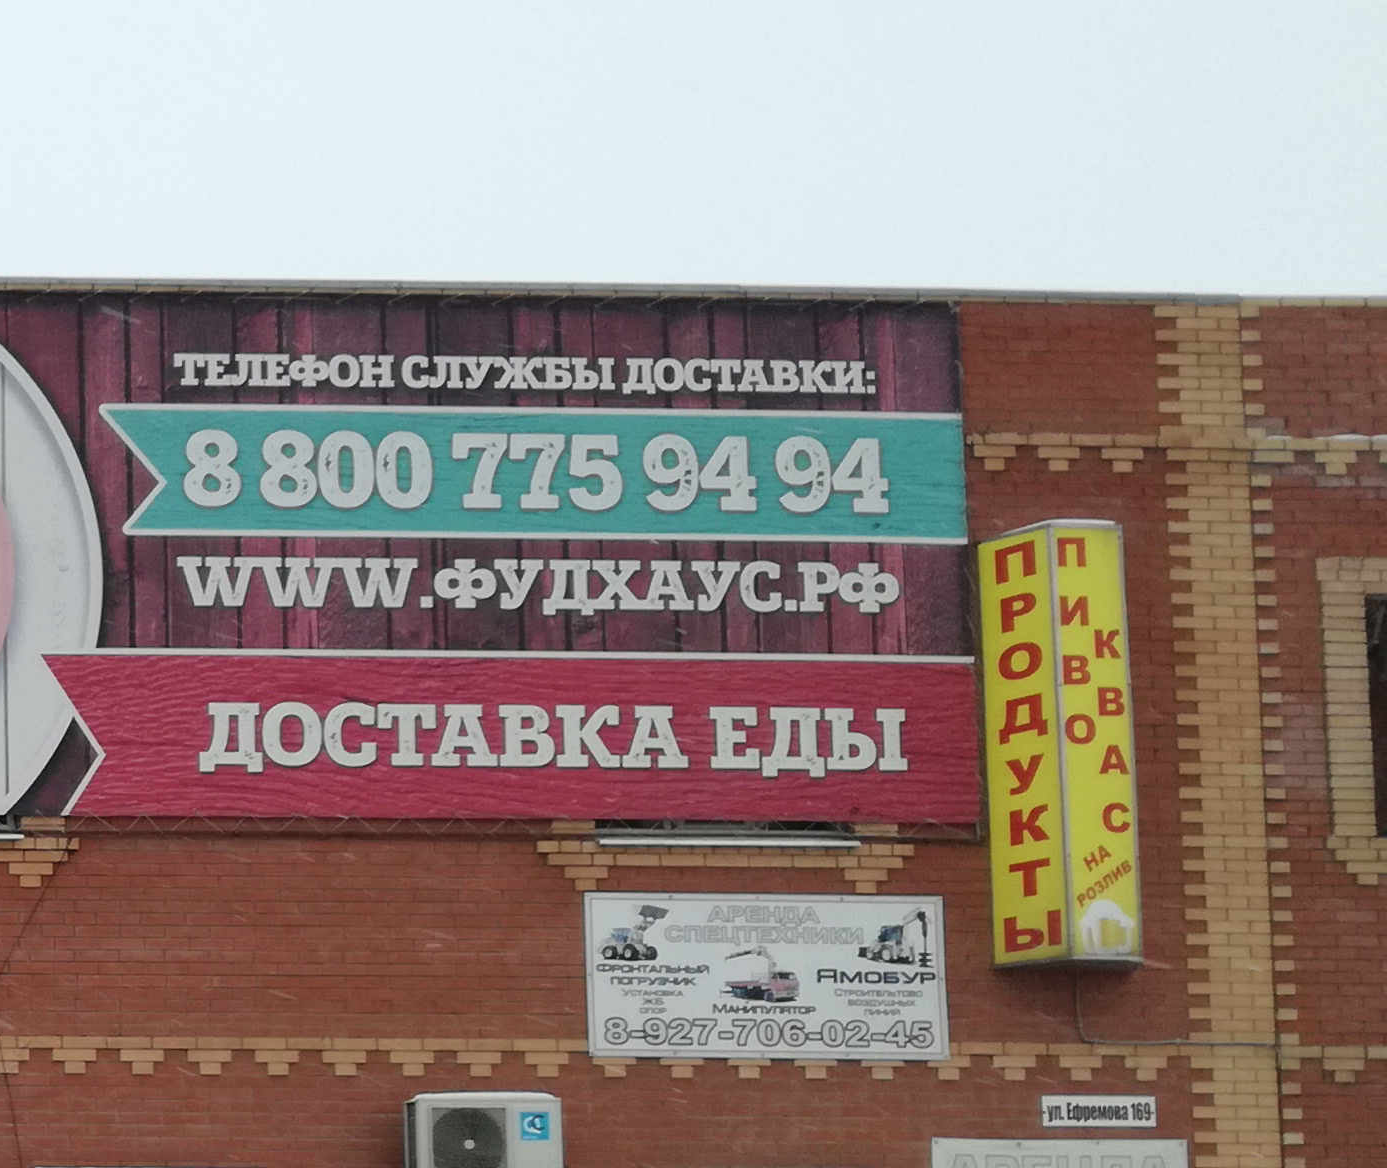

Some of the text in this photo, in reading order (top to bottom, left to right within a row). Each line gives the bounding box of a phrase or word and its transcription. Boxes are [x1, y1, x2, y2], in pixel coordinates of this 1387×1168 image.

[173, 353, 876, 395] ТЕЛЕФОН СЛУЖБЫ ДОСТАВКИ:
[183, 429, 890, 514] 8 800 775 94 94
[1056, 536, 1097, 745] ПИВО
[198, 700, 910, 780] ДОСТАВКА ЕДЫ
[1093, 629, 1131, 833] КВАС
[994, 539, 1063, 954] ПРОДУКТЫ
[1083, 844, 1112, 872] НА
[1077, 860, 1132, 908] РОЗЛИВ
[707, 904, 821, 927] АРЕНДА
[664, 924, 864, 946] СПЕЦТЕХНИКИ
[595, 963, 710, 975] ФРОНТАЛЬНЫЙ
[610, 976, 697, 987] ПОГРУЗЧИК
[816, 968, 936, 985] ЯМОБУР
[712, 1003, 817, 1015] МАНИПУЛЯТОР
[604, 1016, 935, 1049] 8-927-706-02-45
[1047, 1102, 1151, 1122] ул. Ефремова 169
